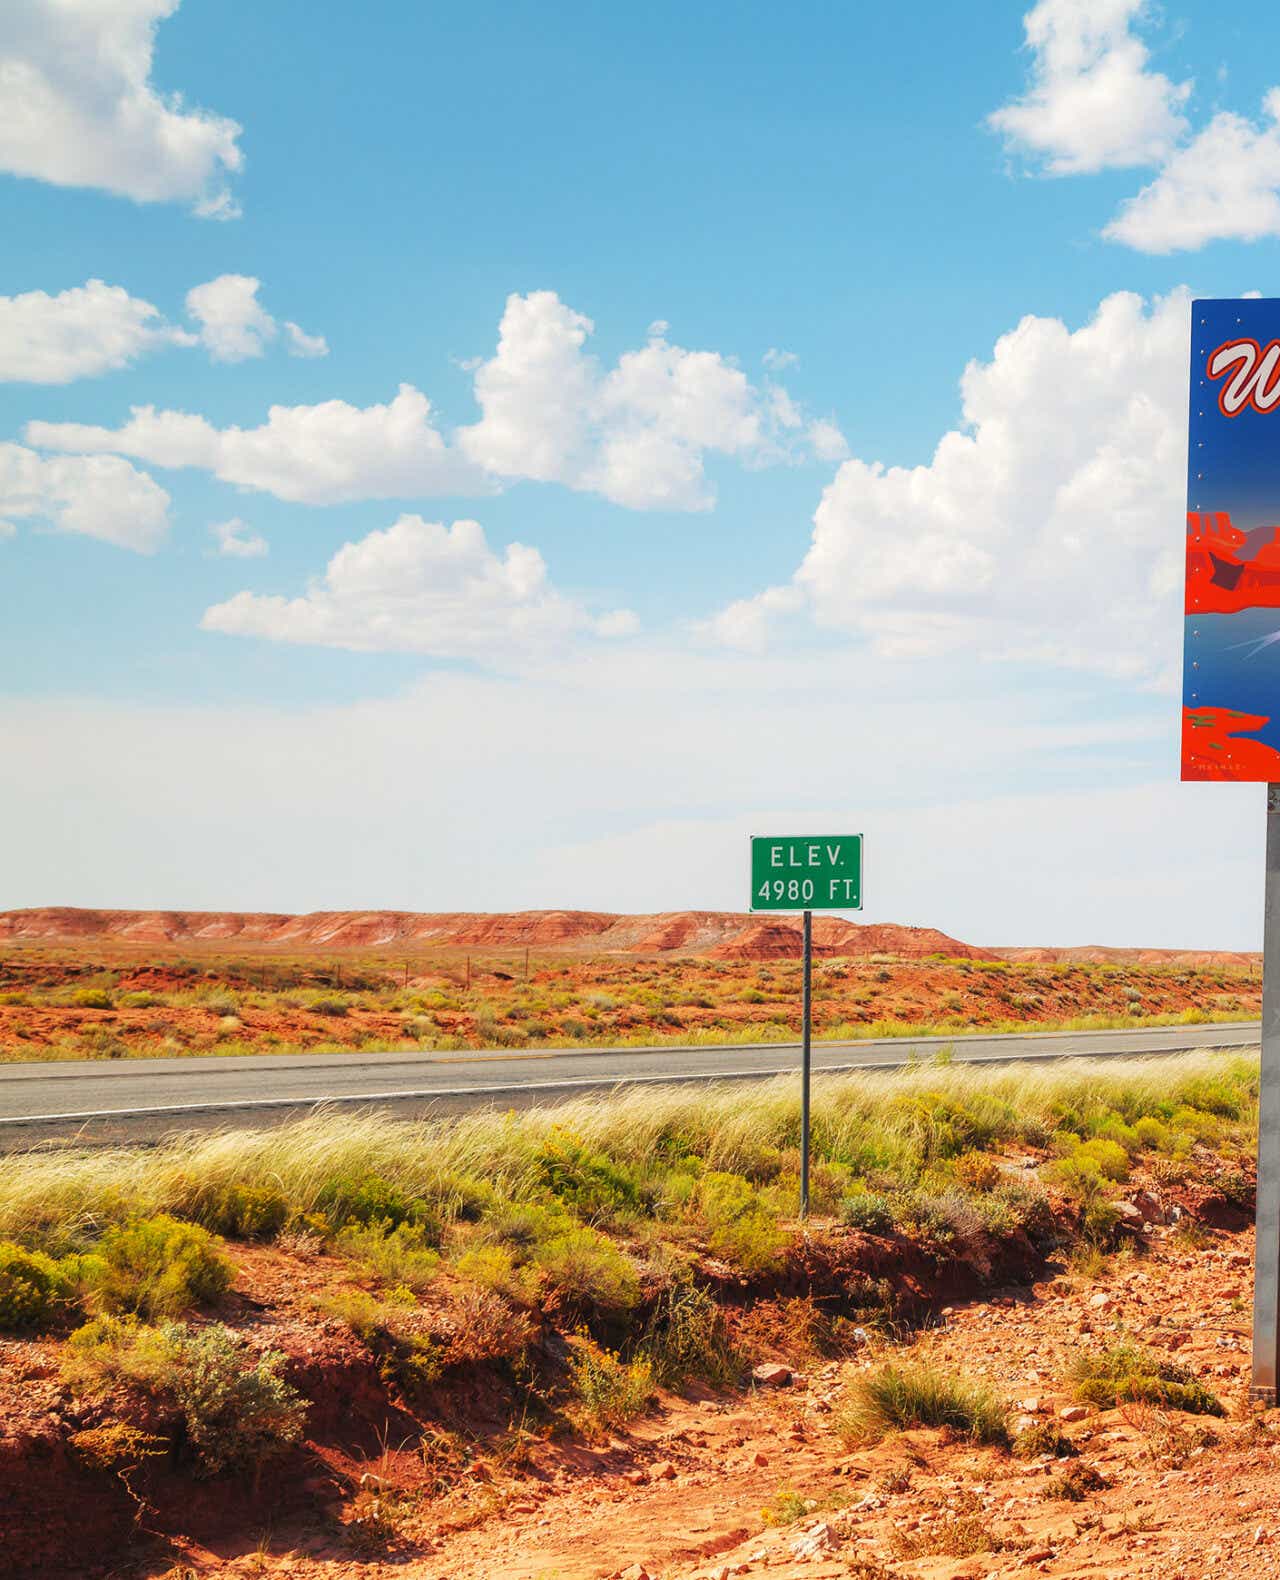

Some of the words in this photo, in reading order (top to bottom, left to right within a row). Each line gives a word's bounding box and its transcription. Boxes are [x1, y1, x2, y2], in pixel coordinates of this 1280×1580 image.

[771, 845, 844, 867] ELEV.
[758, 879, 814, 901] 4980
[829, 879, 857, 900] FT.
